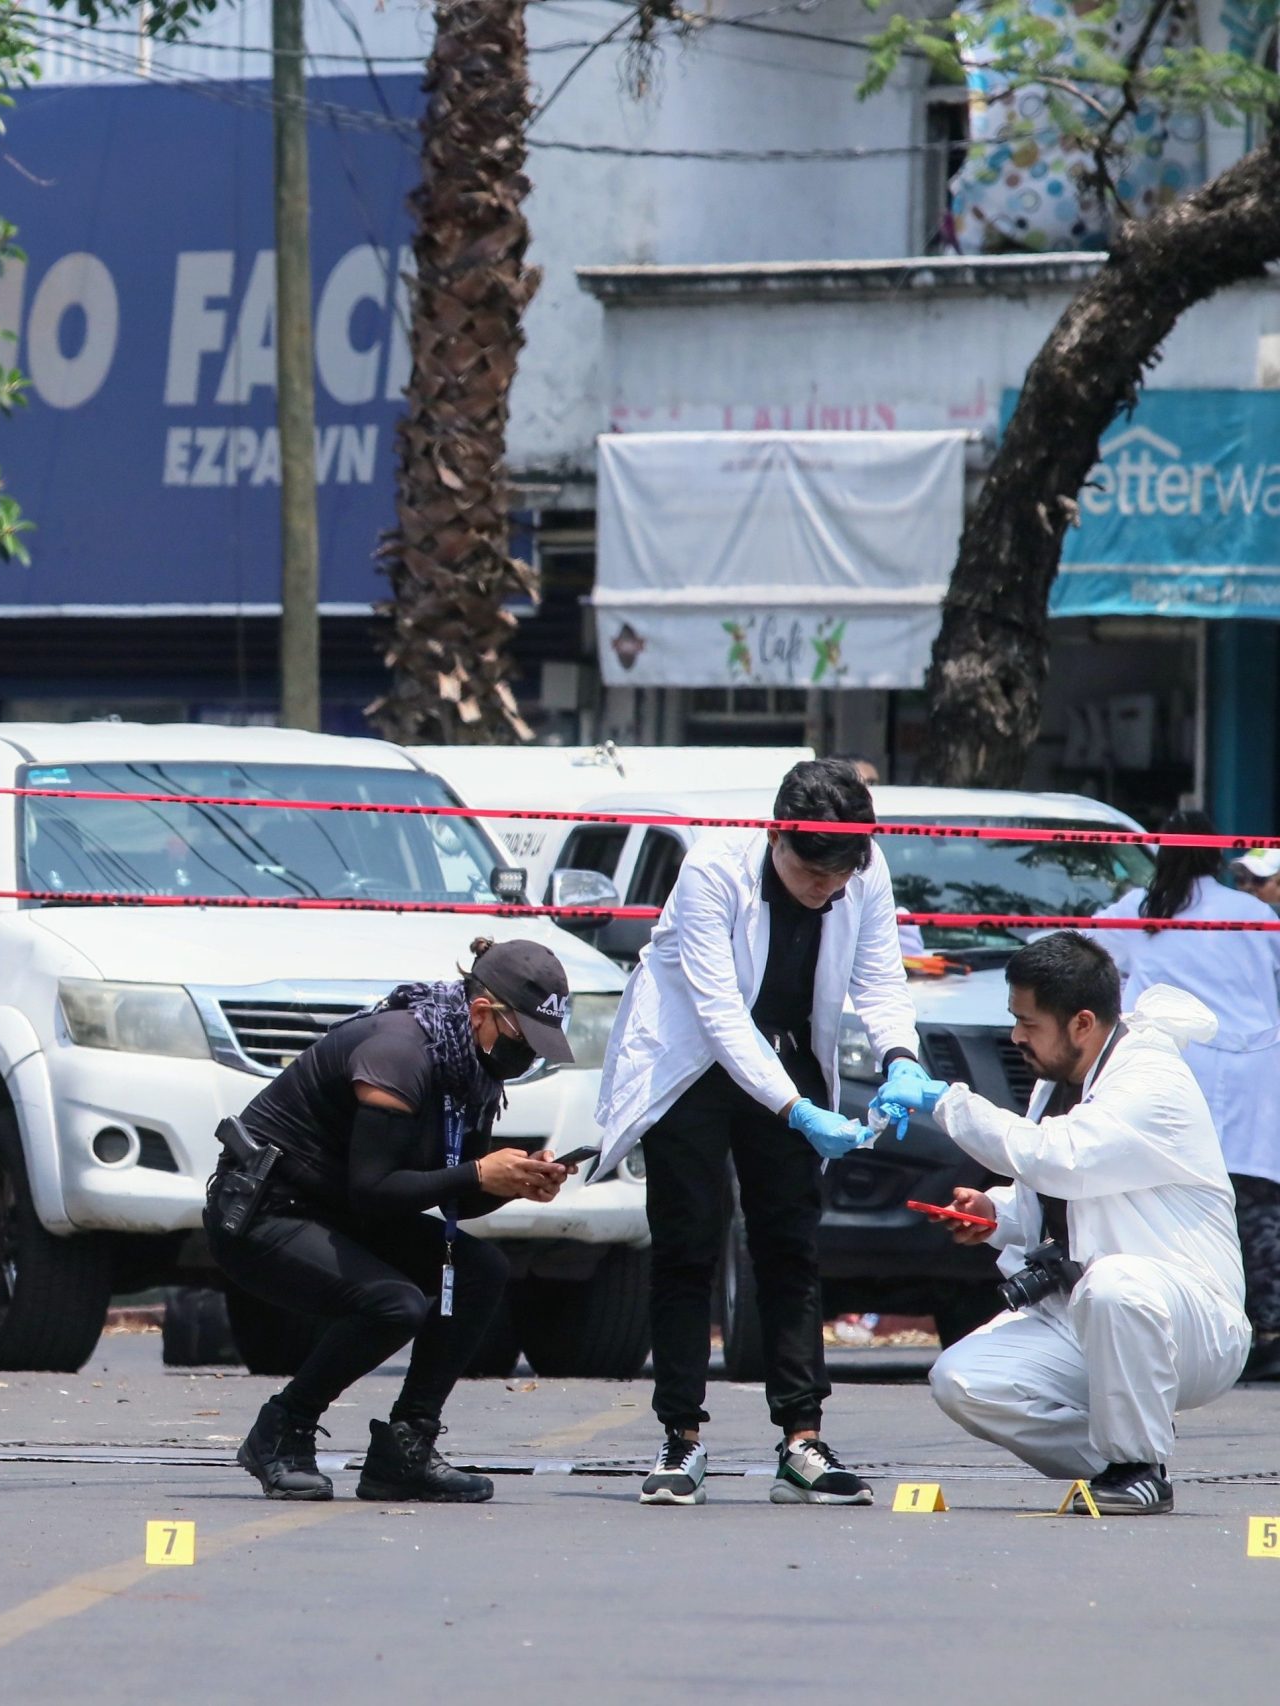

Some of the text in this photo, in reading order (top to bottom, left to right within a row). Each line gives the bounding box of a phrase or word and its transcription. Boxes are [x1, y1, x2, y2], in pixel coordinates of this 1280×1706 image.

[1080, 450, 1280, 515] etterw
[910, 1488, 920, 1506] 1
[163, 1528, 177, 1555] 7
[1263, 1523, 1277, 1548] 5
